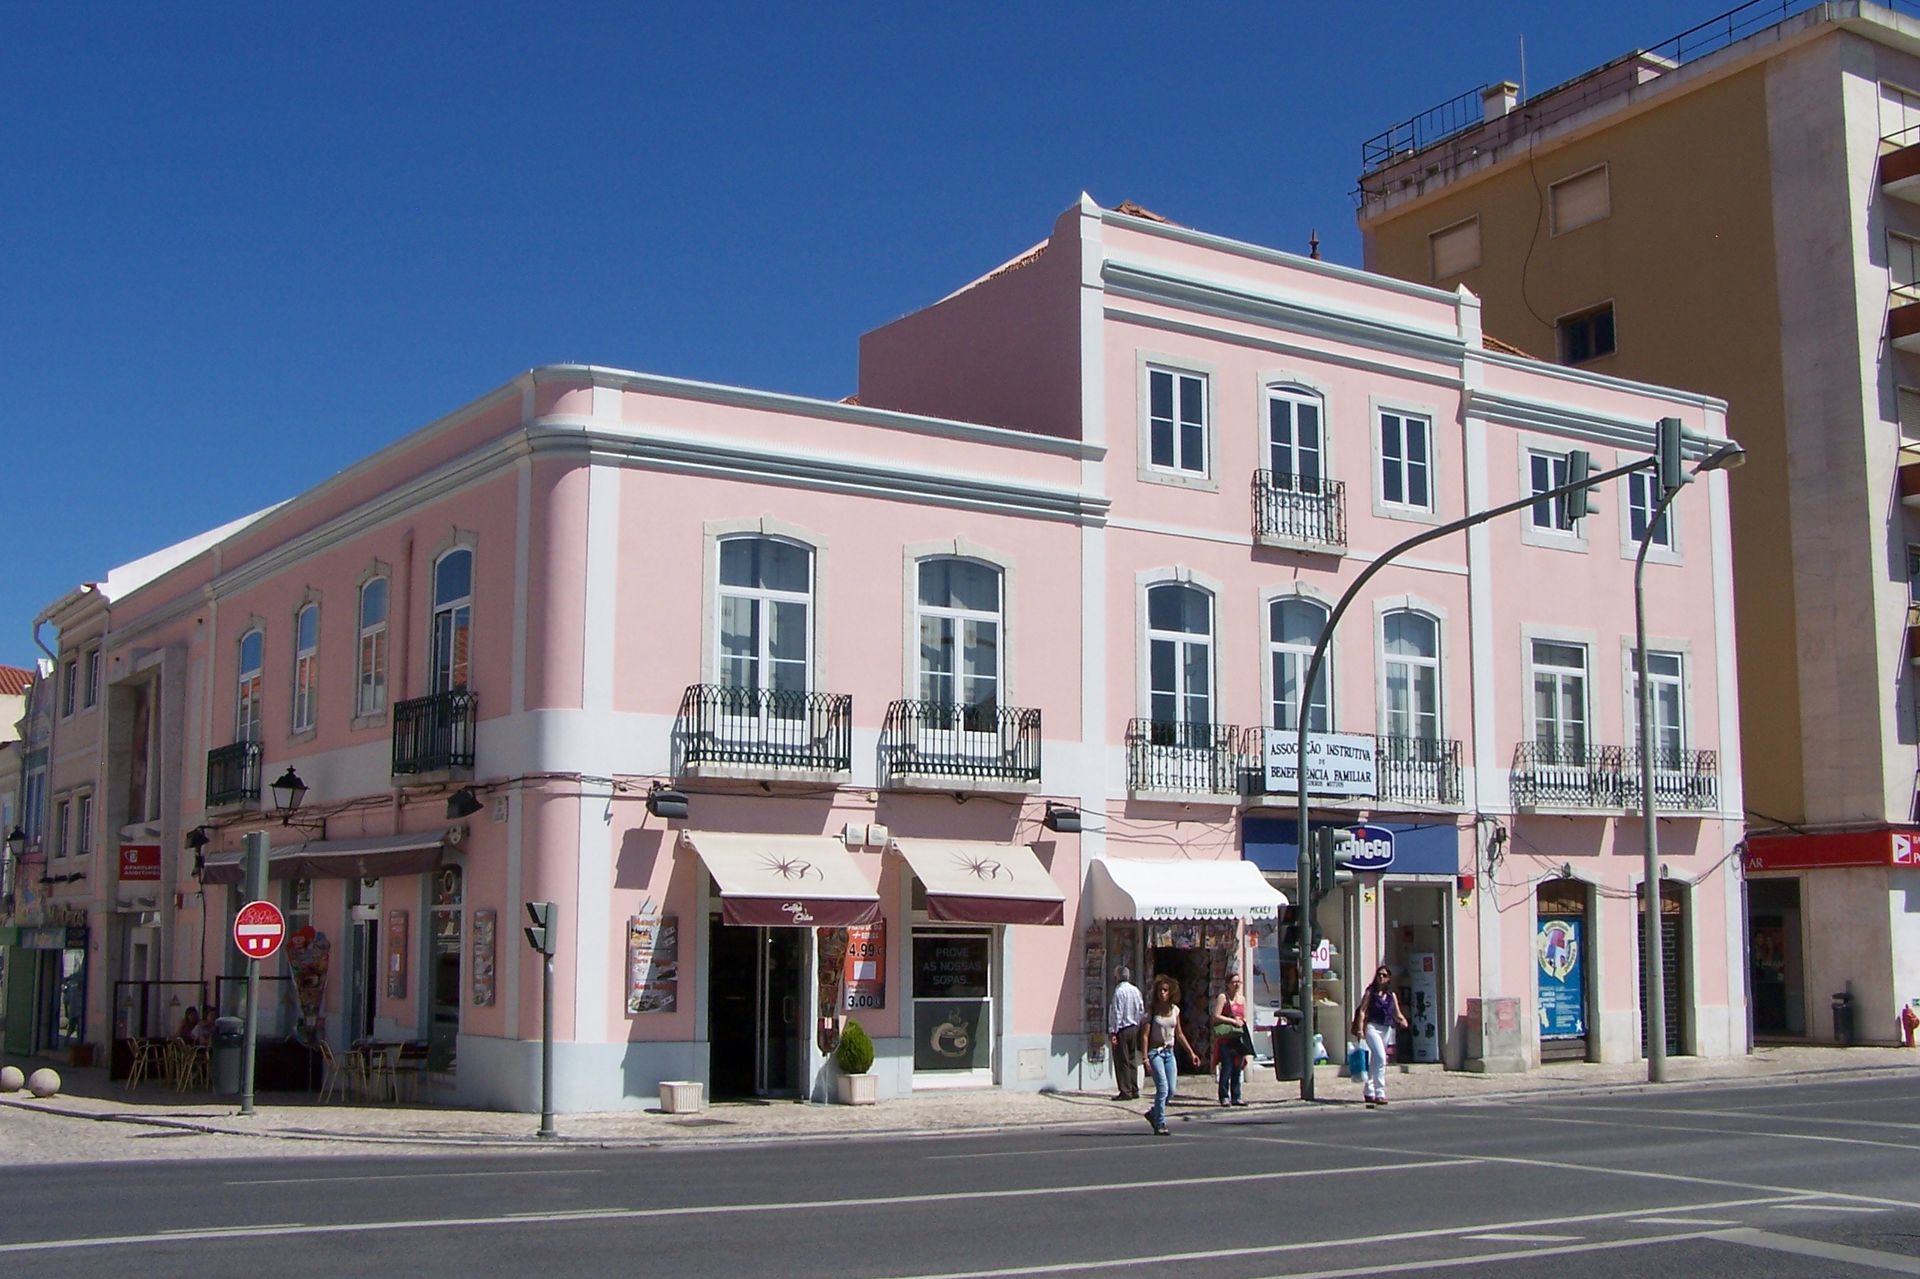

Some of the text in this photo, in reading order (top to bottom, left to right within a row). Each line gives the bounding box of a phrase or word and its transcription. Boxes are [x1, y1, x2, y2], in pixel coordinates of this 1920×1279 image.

[1270, 741, 1371, 761] ASSOCÇÃO INSTRUTIVA
[1270, 766, 1372, 783] BENEFIÊNCIA FAMILIAR
[1342, 829, 1391, 860] chicco
[1153, 906, 1178, 916] MICKEY
[1192, 907, 1235, 916] TABACARIA
[1249, 905, 1272, 915] MICKEY
[849, 943, 875, 957] 4.99
[847, 995, 874, 1008] 3.00
